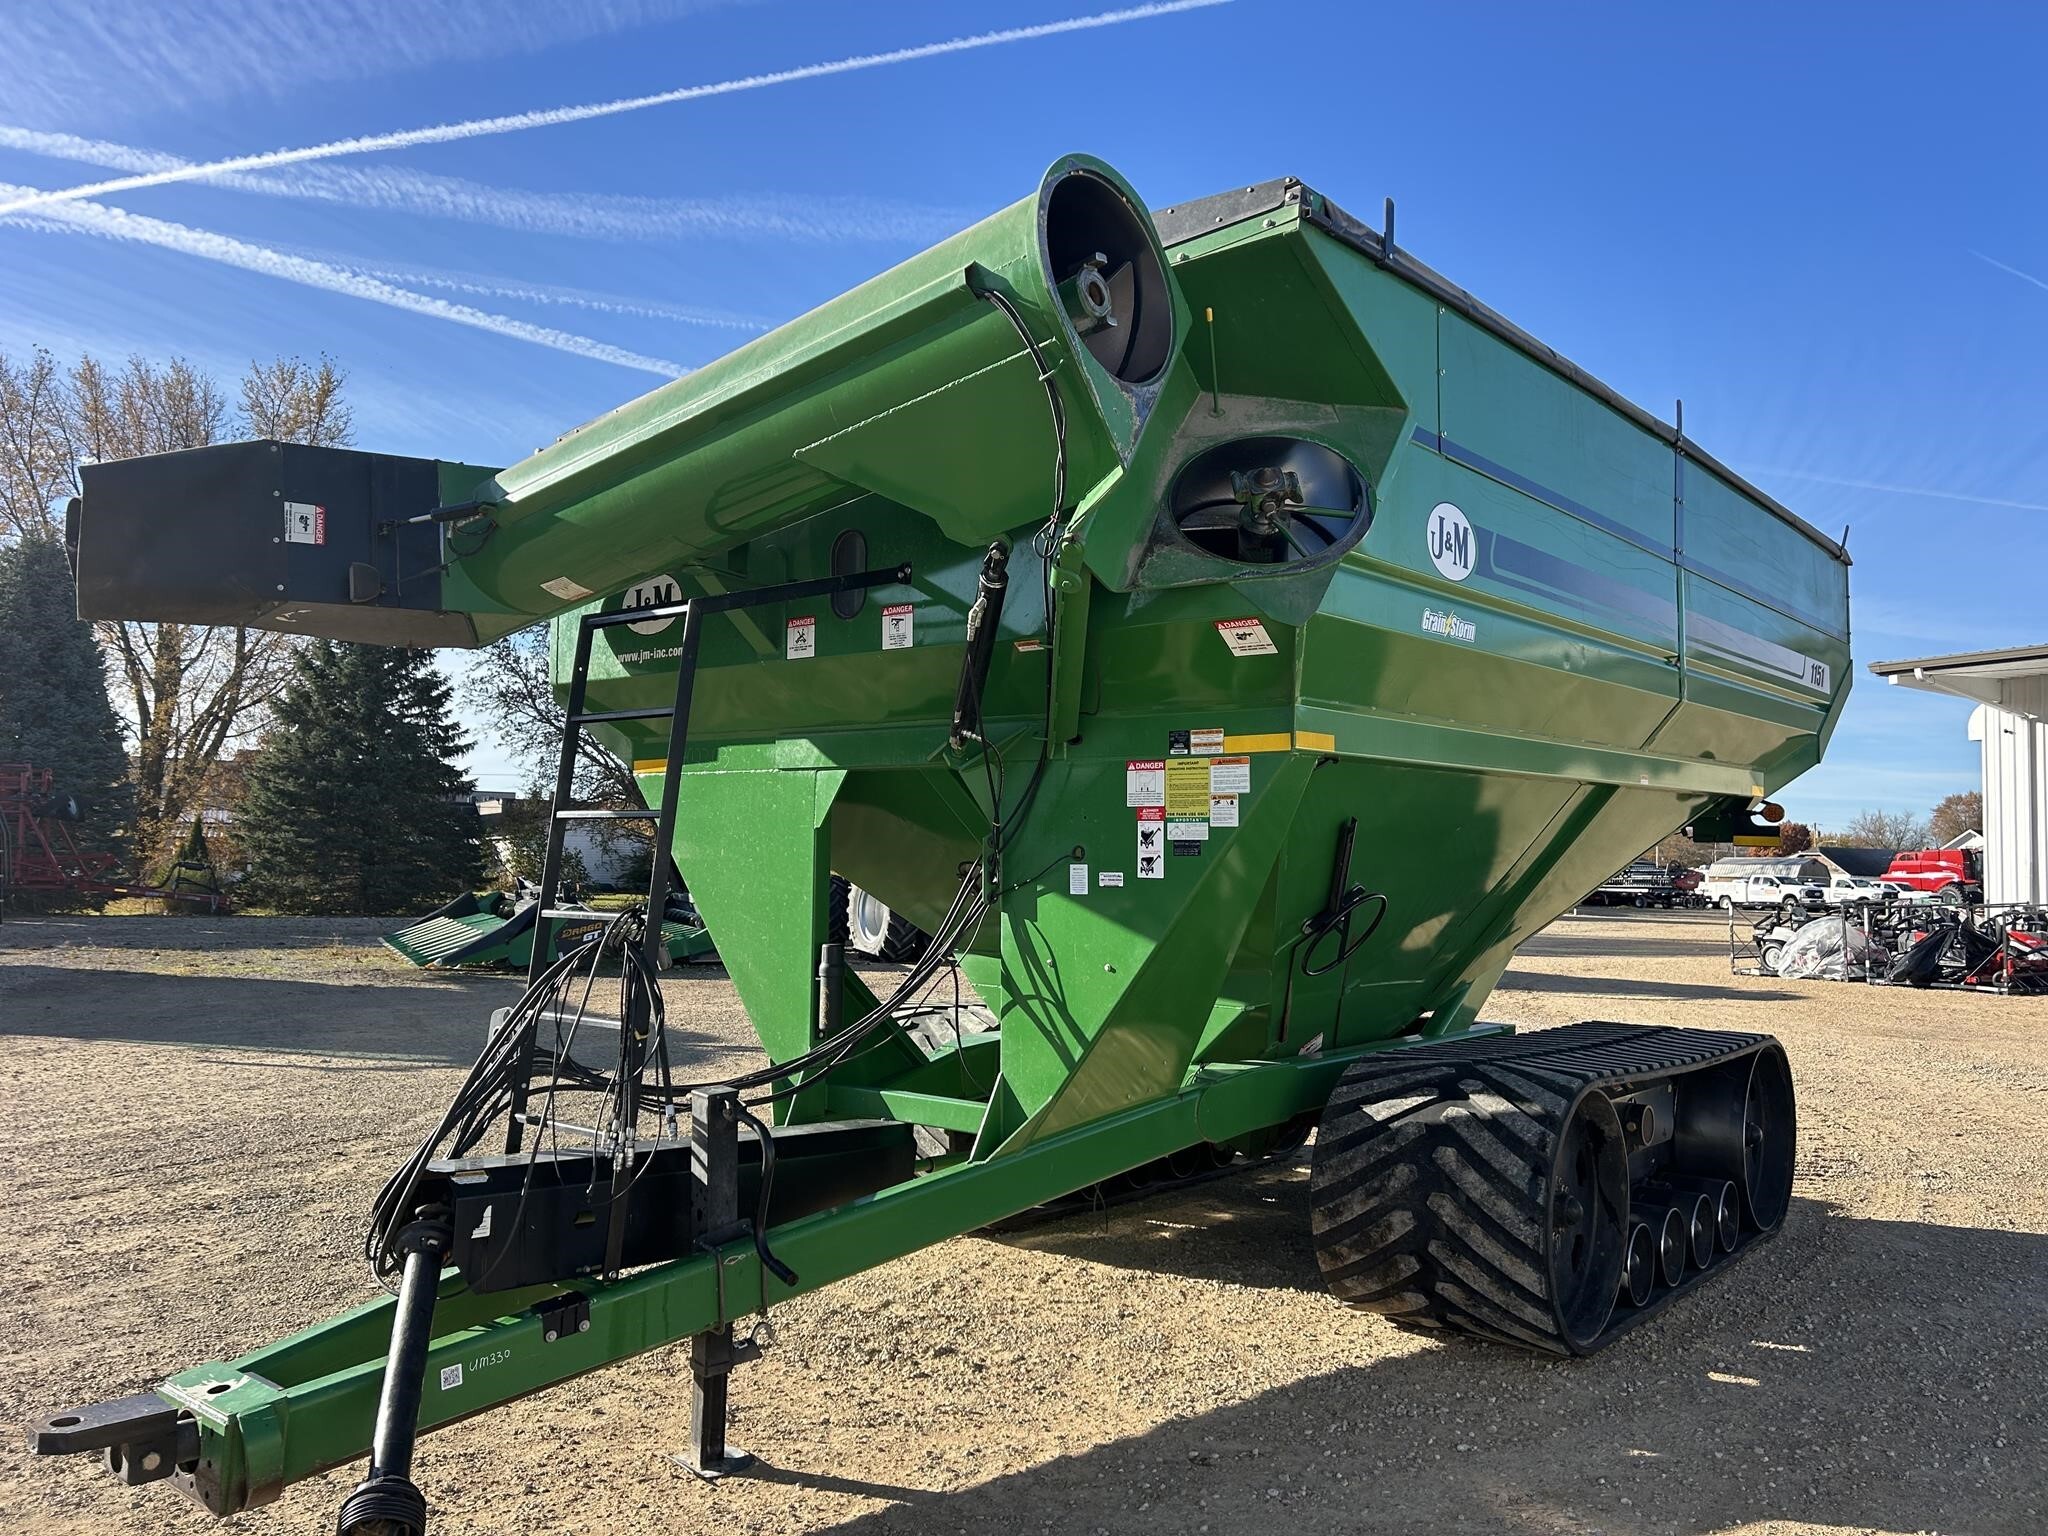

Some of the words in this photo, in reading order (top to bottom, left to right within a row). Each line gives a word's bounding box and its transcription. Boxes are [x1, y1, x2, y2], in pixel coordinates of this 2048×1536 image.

[1430, 515, 1470, 570] J&M
[888, 604, 913, 615] DANGER
[793, 618, 815, 627] DANGER
[1225, 619, 1260, 630] DANGER
[1422, 608, 1447, 635] Grain
[1450, 614, 1476, 642] Storm
[1810, 663, 1825, 688] 1151
[582, 930, 602, 942] GT
